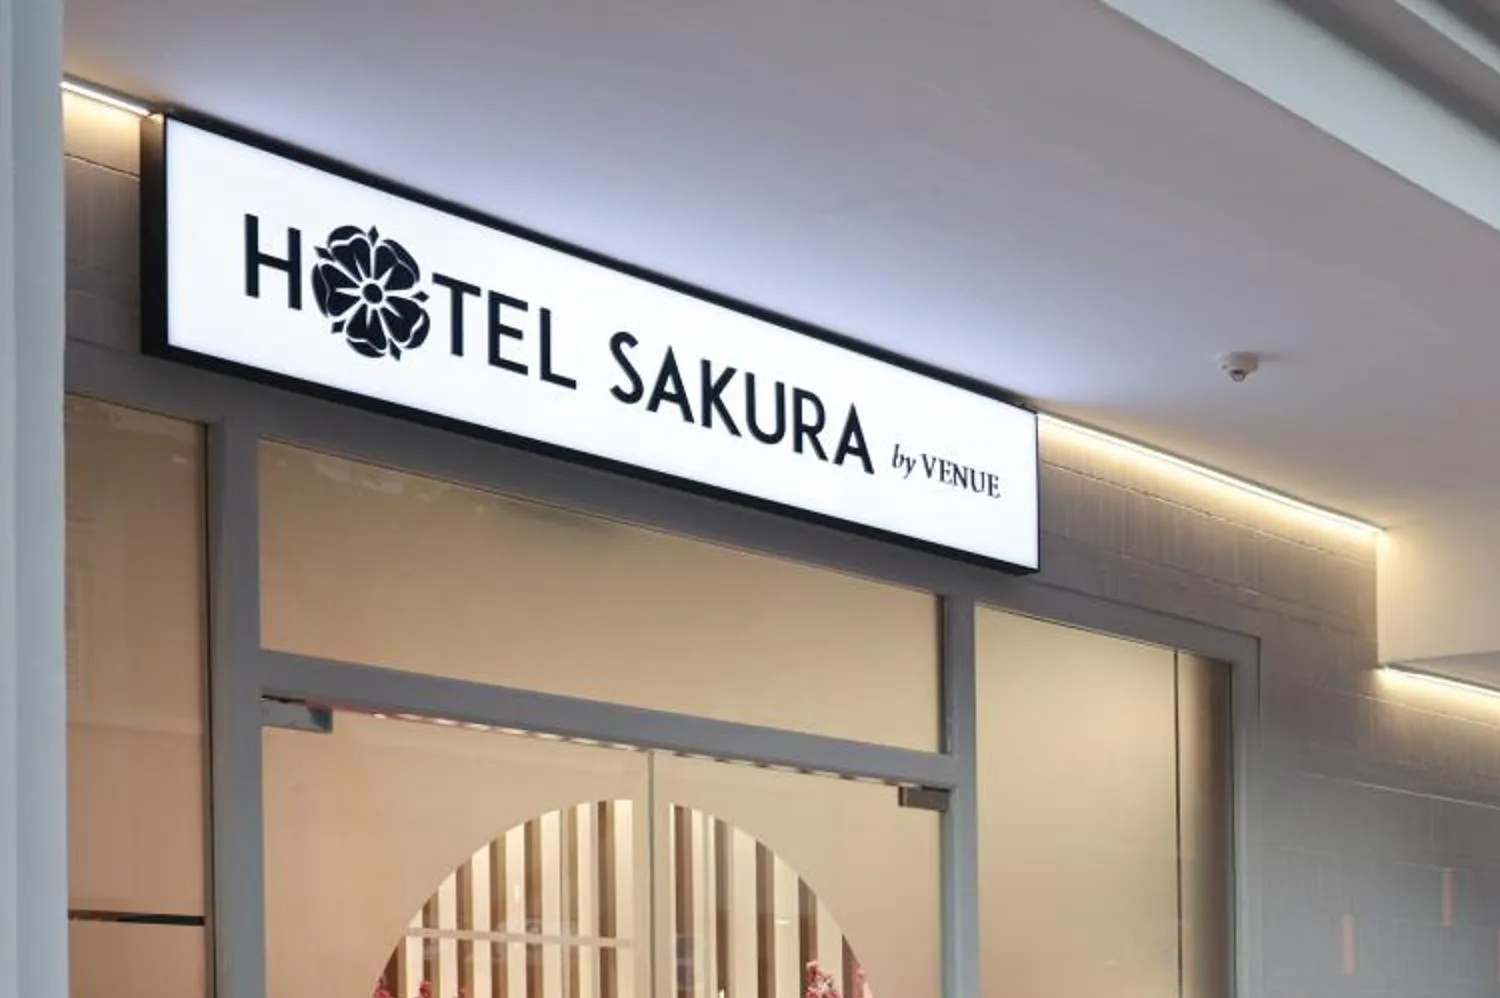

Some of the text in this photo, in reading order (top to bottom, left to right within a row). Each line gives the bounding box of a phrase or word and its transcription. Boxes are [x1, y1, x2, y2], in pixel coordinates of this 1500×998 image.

[609, 331, 874, 475] SAKURA
[892, 445, 917, 479] by
[920, 454, 1001, 498] VENUE
